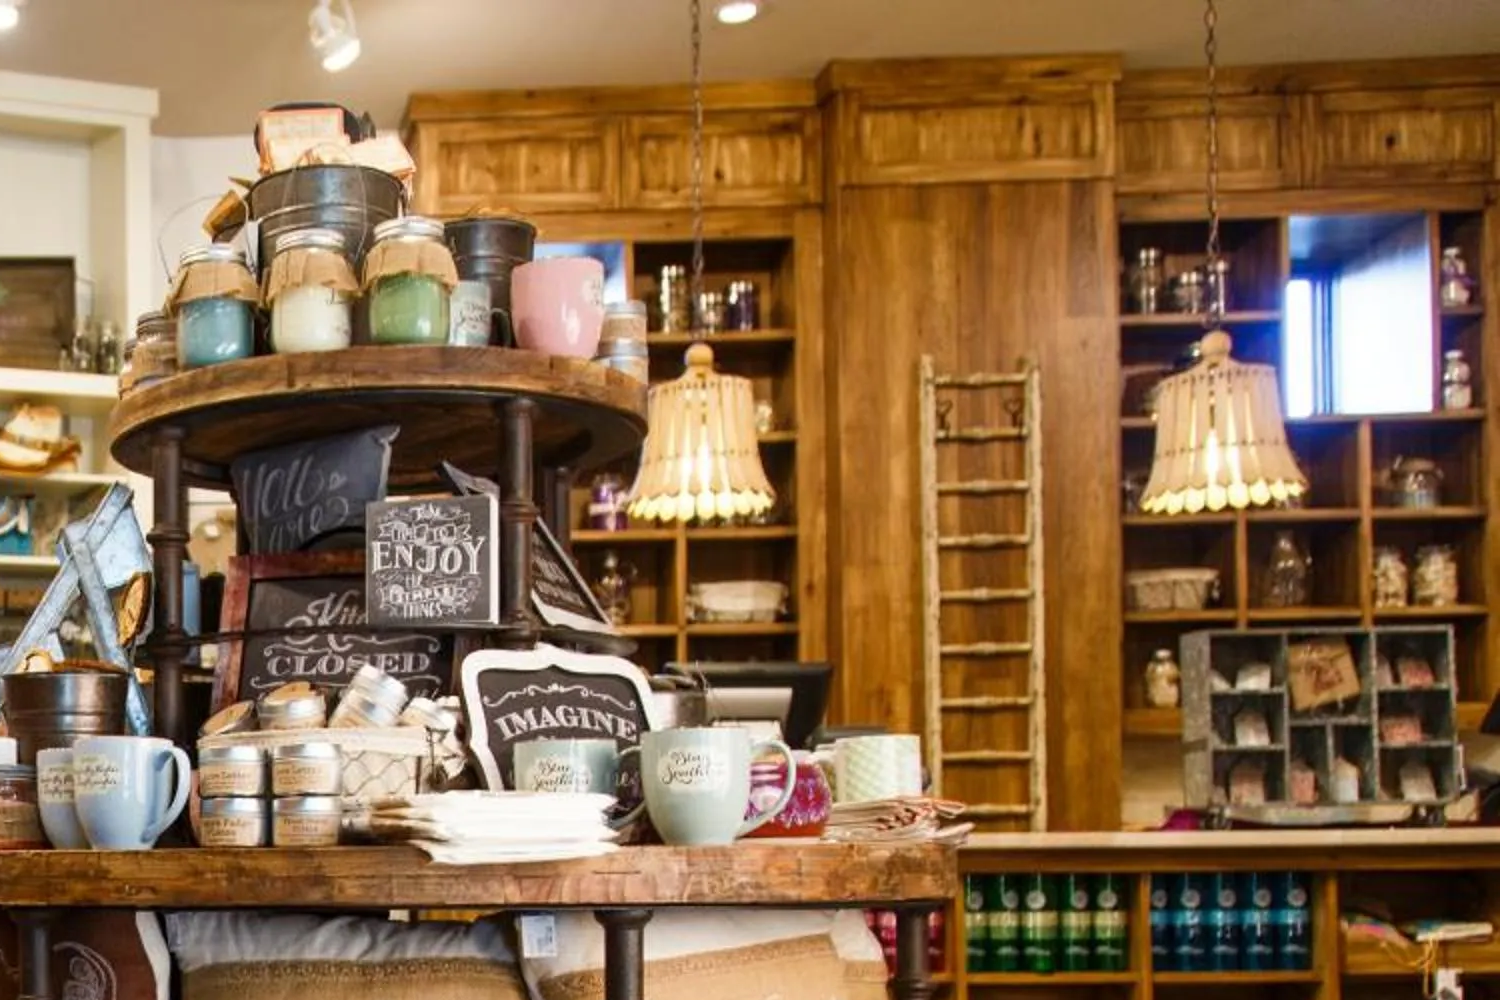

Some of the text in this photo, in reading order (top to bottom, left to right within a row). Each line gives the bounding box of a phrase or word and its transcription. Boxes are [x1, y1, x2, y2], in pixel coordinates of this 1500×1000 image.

[371, 536, 485, 575] ENJOY
[266, 652, 431, 677] CLOSED
[494, 704, 639, 742] IMAGINE
